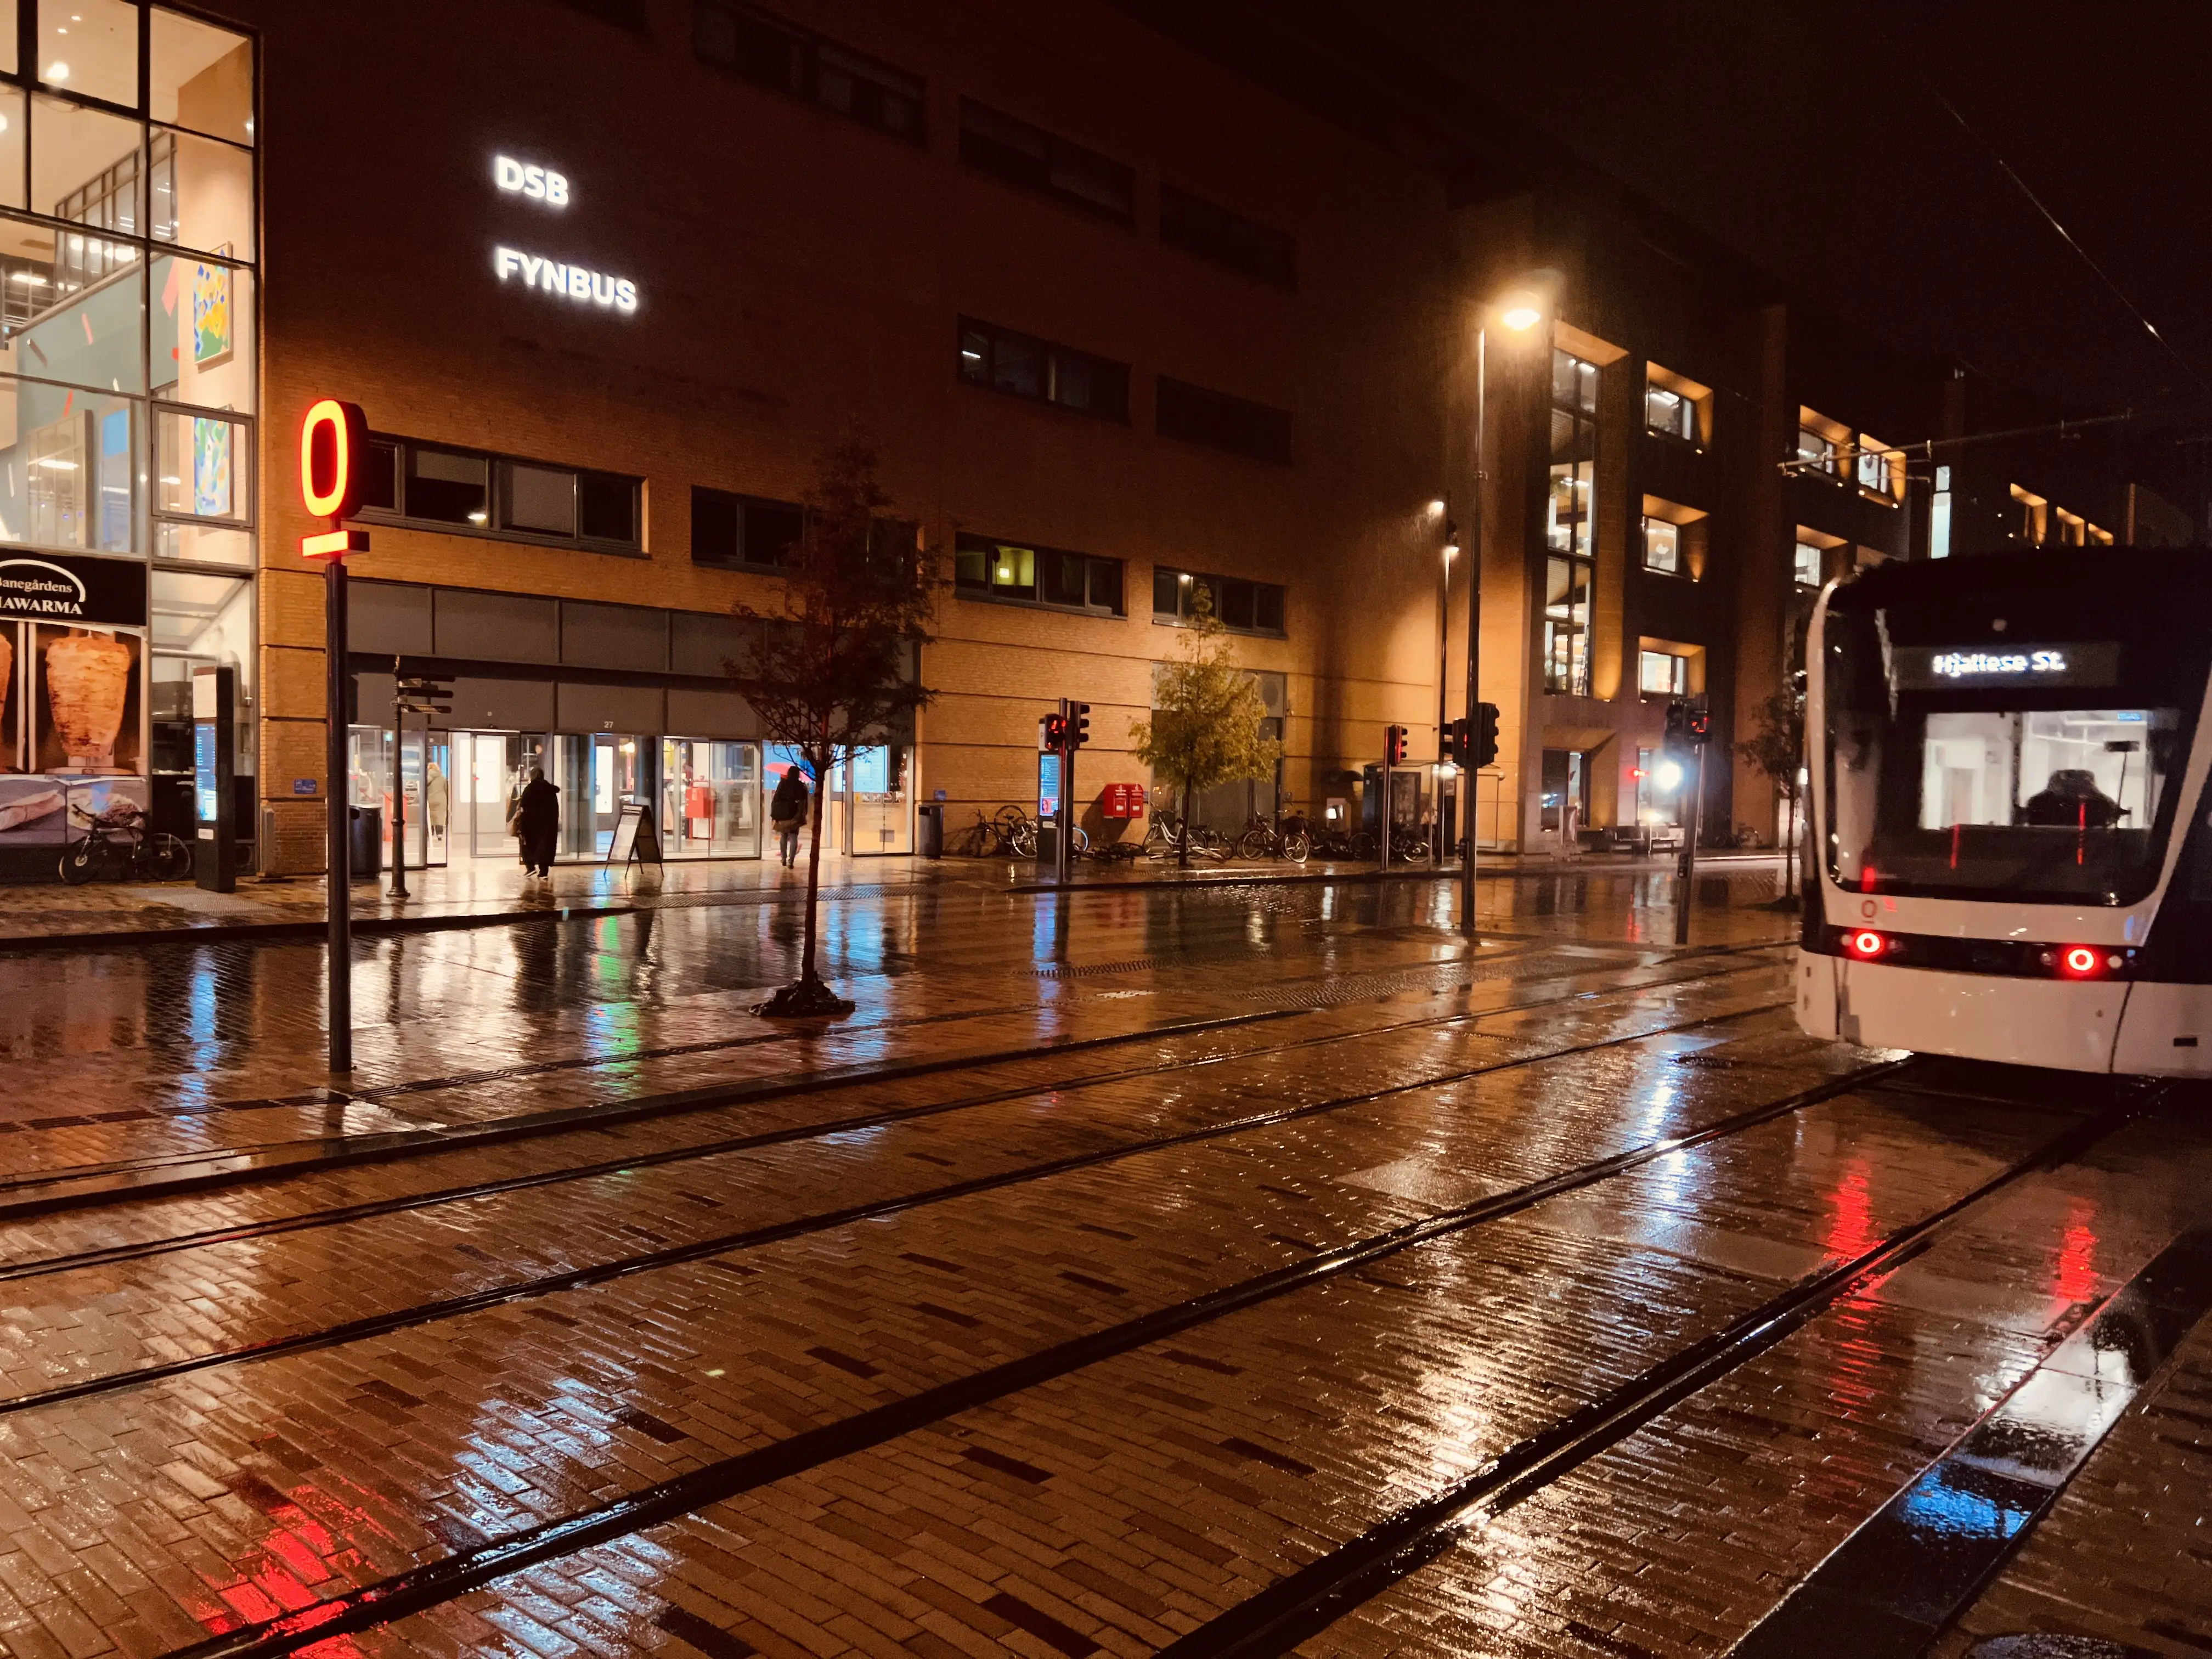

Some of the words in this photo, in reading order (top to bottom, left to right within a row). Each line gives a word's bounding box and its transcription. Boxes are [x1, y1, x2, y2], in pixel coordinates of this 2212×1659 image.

[496, 155, 569, 205] DSB
[497, 247, 637, 311] FYNBUS
[2031, 651, 2066, 670] St.
